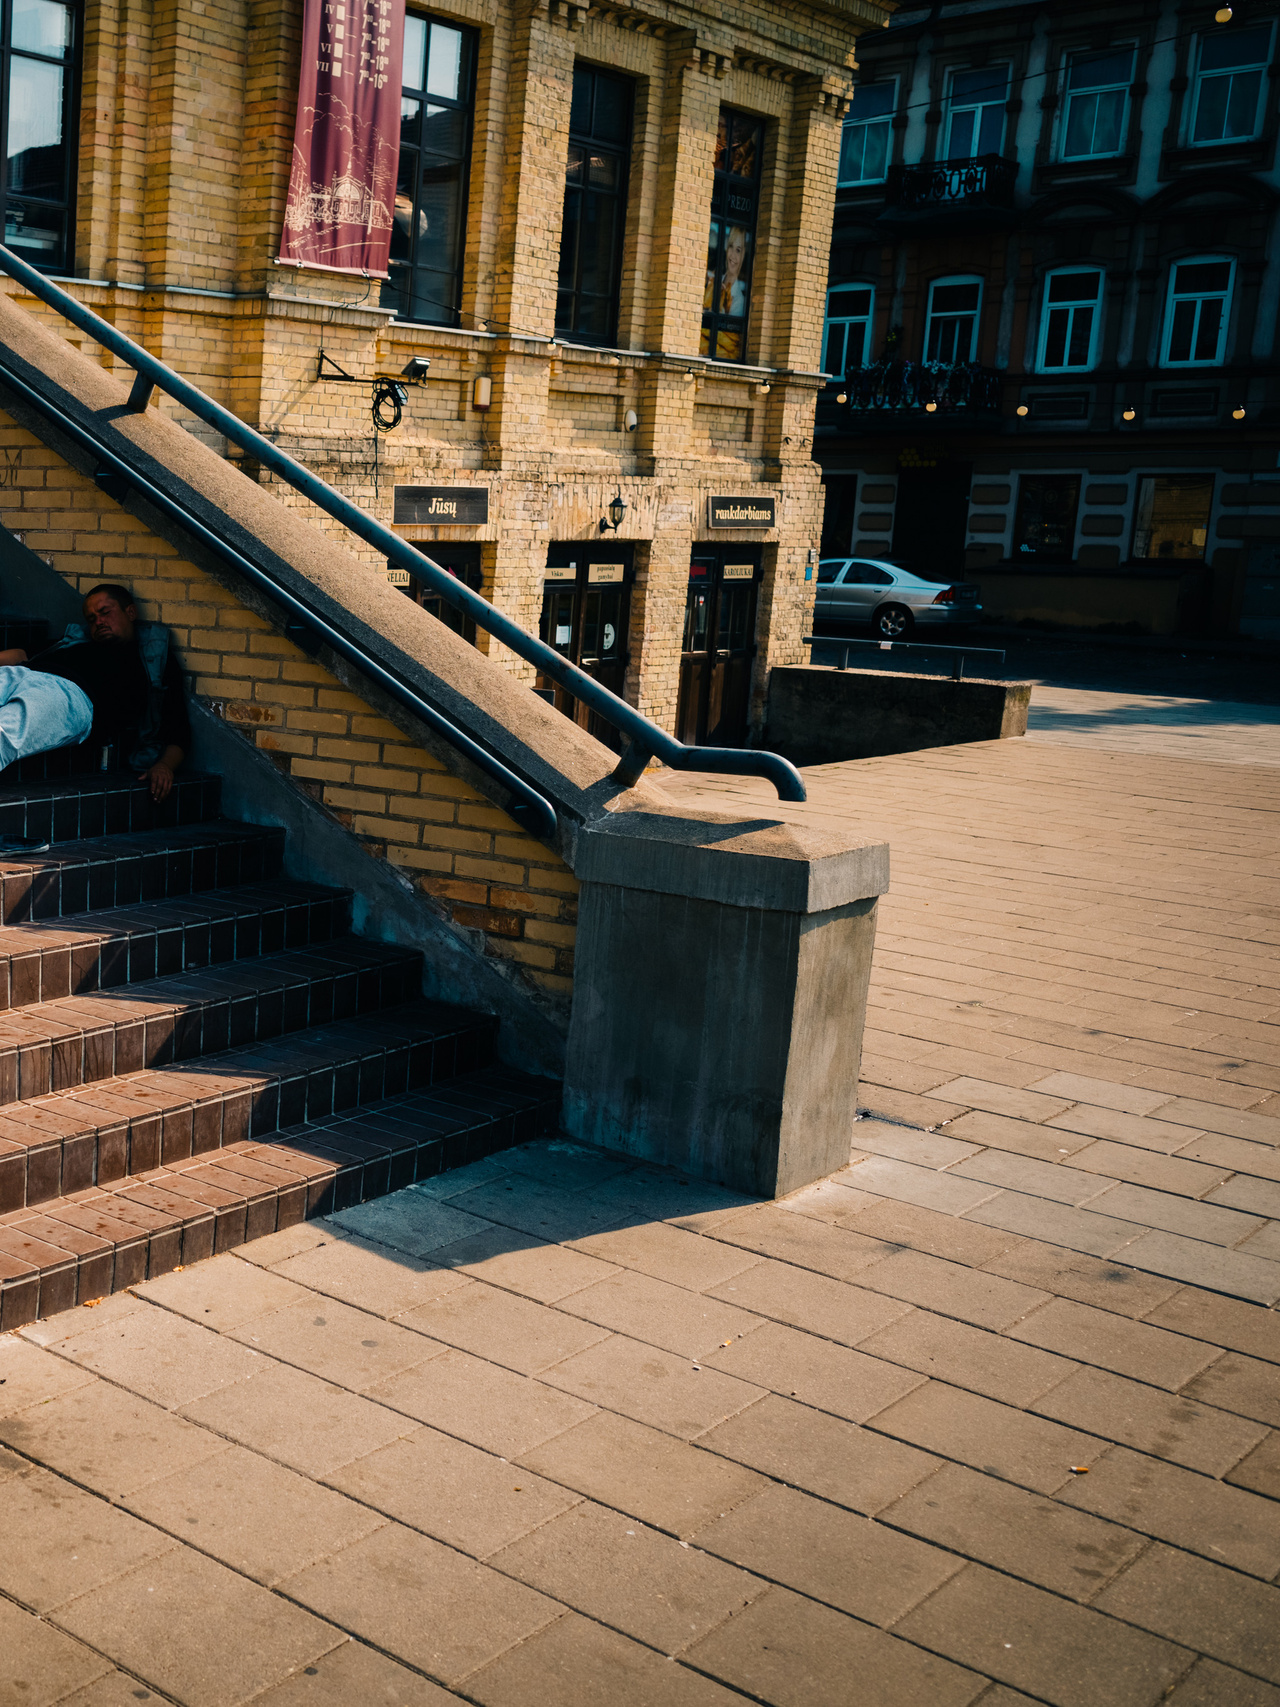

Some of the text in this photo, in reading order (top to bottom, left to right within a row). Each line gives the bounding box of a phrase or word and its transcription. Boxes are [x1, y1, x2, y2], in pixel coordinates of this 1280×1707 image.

[325, 4, 335, 15] IV
[326, 23, 334, 33] V
[321, 42, 332, 53] VI
[316, 60, 329, 72] VII
[428, 497, 457, 518] Jūsų
[715, 505, 772, 521] rankdarbiams
